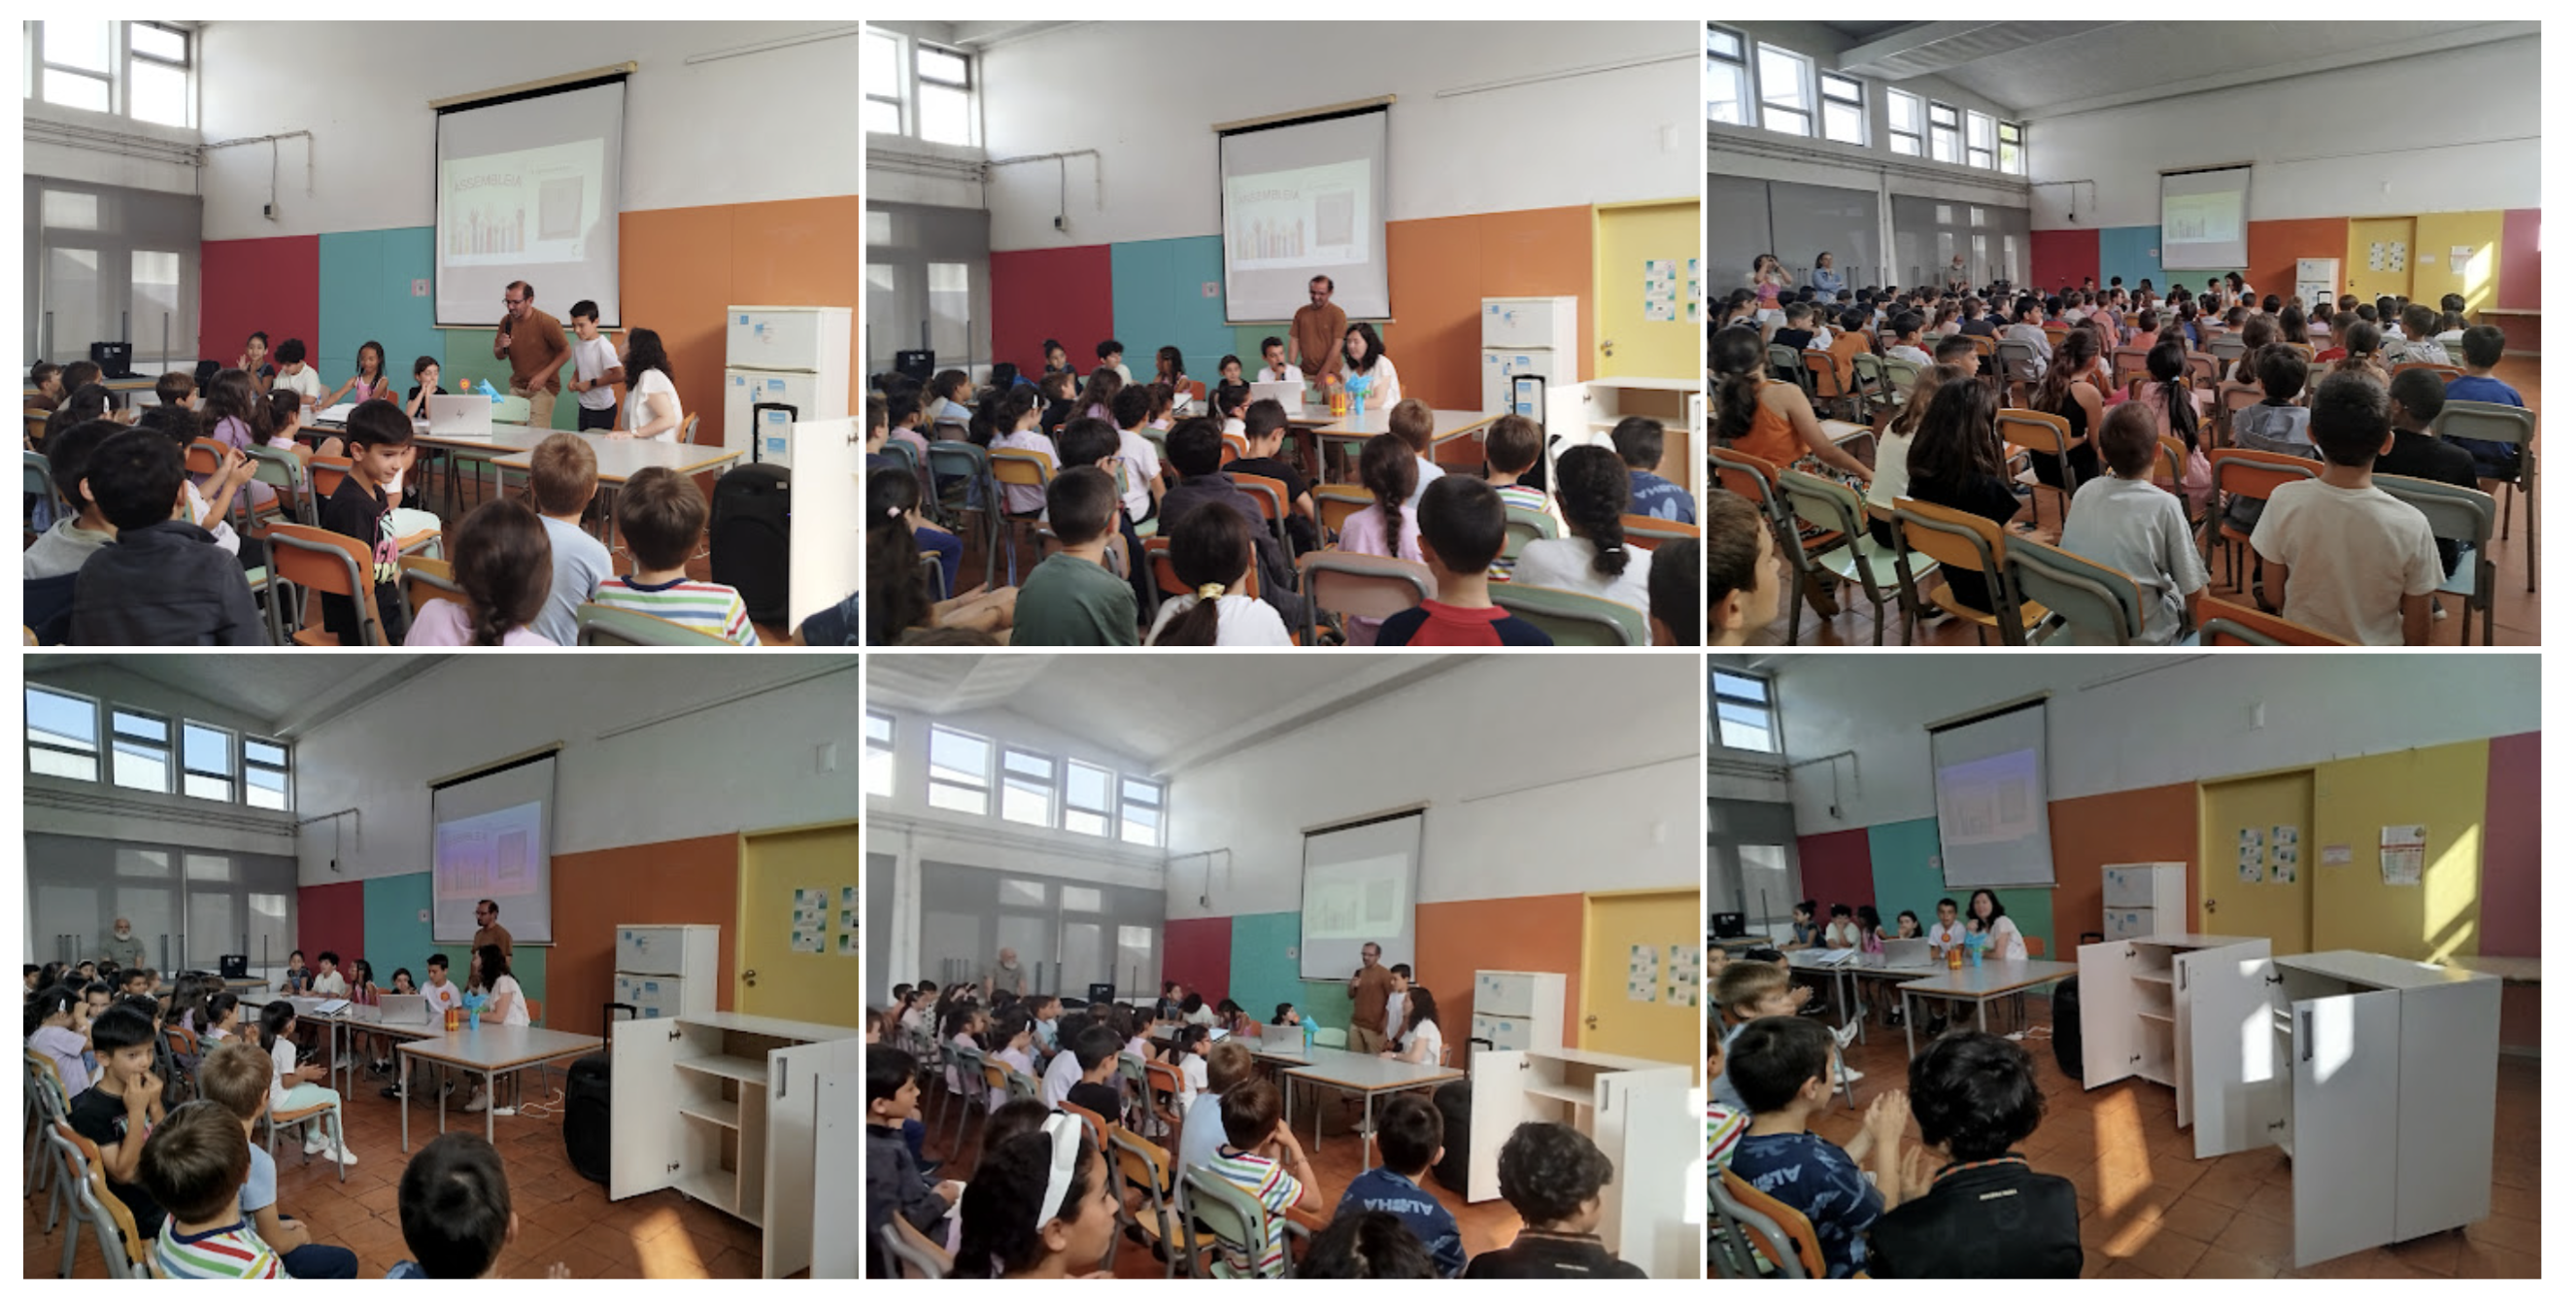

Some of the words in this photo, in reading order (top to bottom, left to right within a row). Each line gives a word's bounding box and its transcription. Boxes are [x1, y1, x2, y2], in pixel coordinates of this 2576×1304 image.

[454, 173, 524, 194] ASSEMBLEIA
[1751, 1163, 1802, 1192] ALO
[1364, 1198, 1434, 1216] ALOHA
